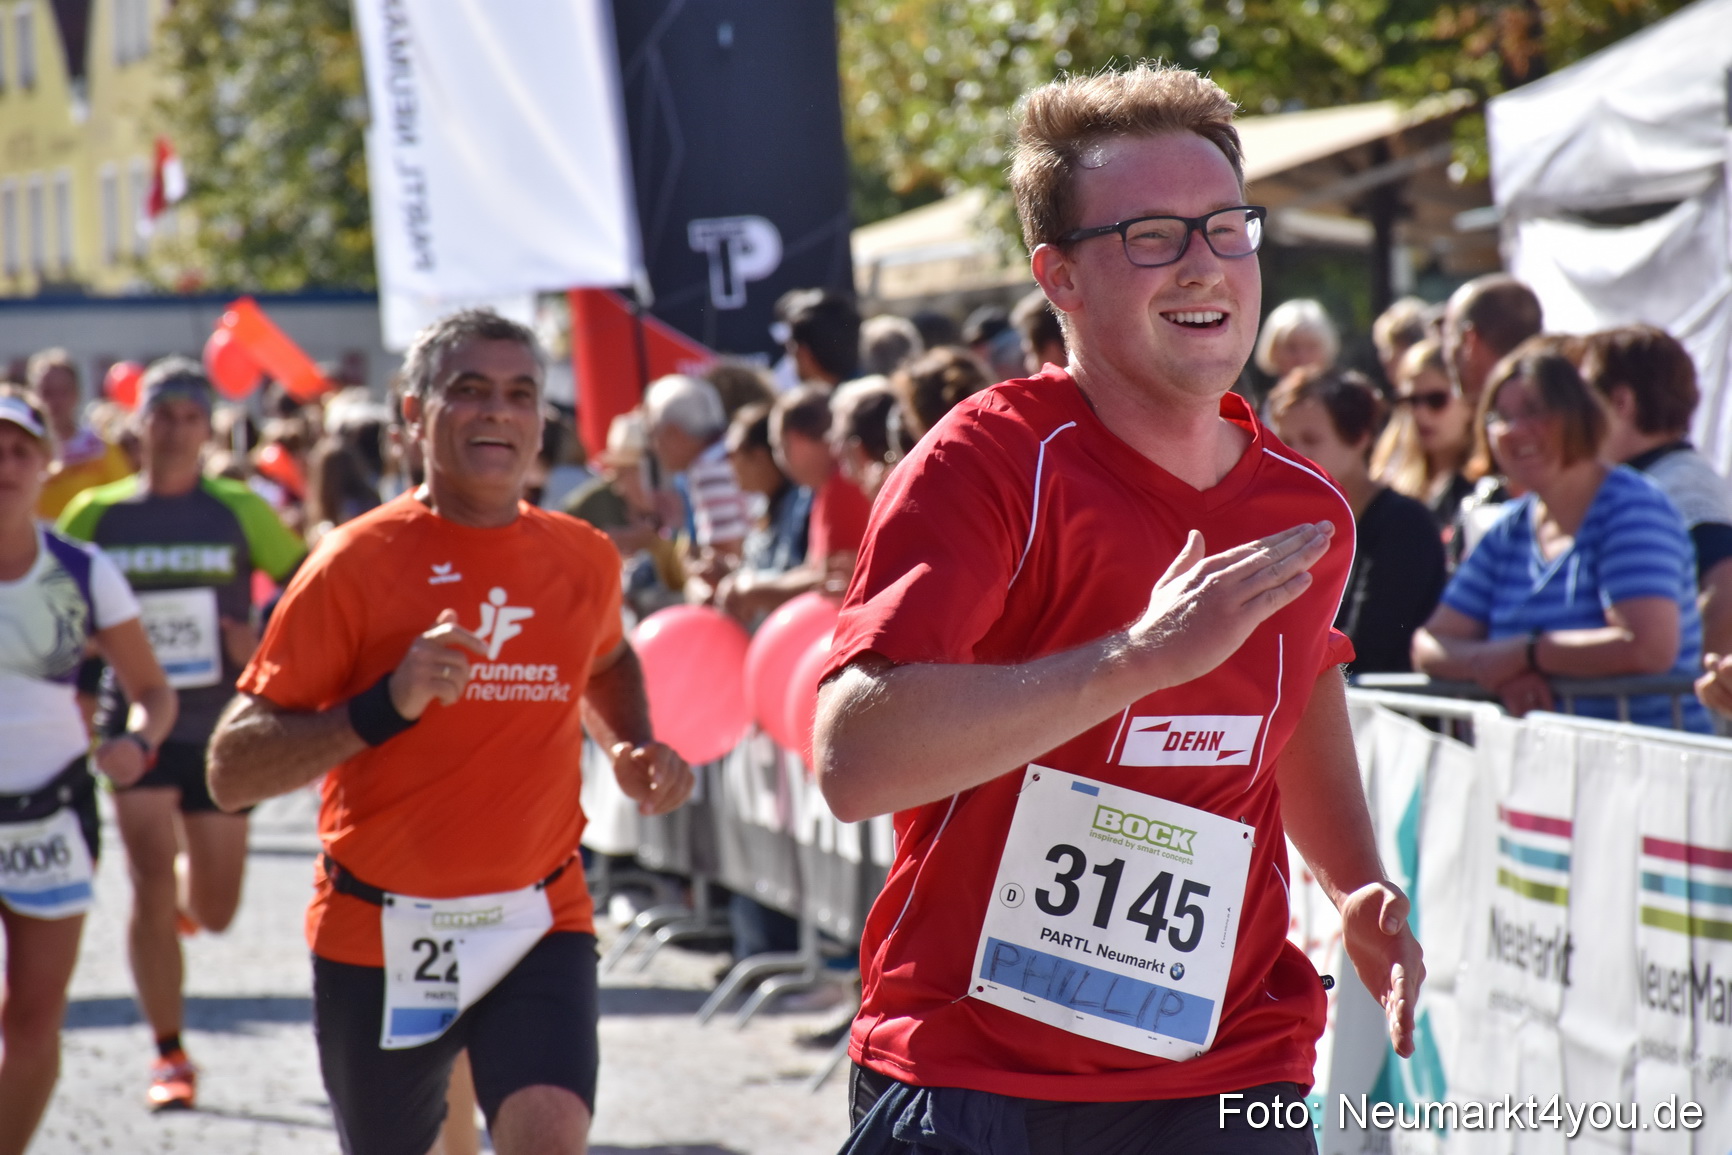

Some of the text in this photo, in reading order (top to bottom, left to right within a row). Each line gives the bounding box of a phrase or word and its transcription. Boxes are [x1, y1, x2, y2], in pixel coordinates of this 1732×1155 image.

[465, 682, 571, 702] neumarkt
[470, 663, 557, 682] runners
[1162, 731, 1225, 752] DEHN
[1089, 829, 1193, 866] inspired by smart concepts
[1092, 804, 1198, 856] BOCK
[1035, 844, 1211, 952] 3145
[1040, 927, 1167, 974] PARTL Neumarkt
[990, 943, 1184, 1034] PHILLIP
